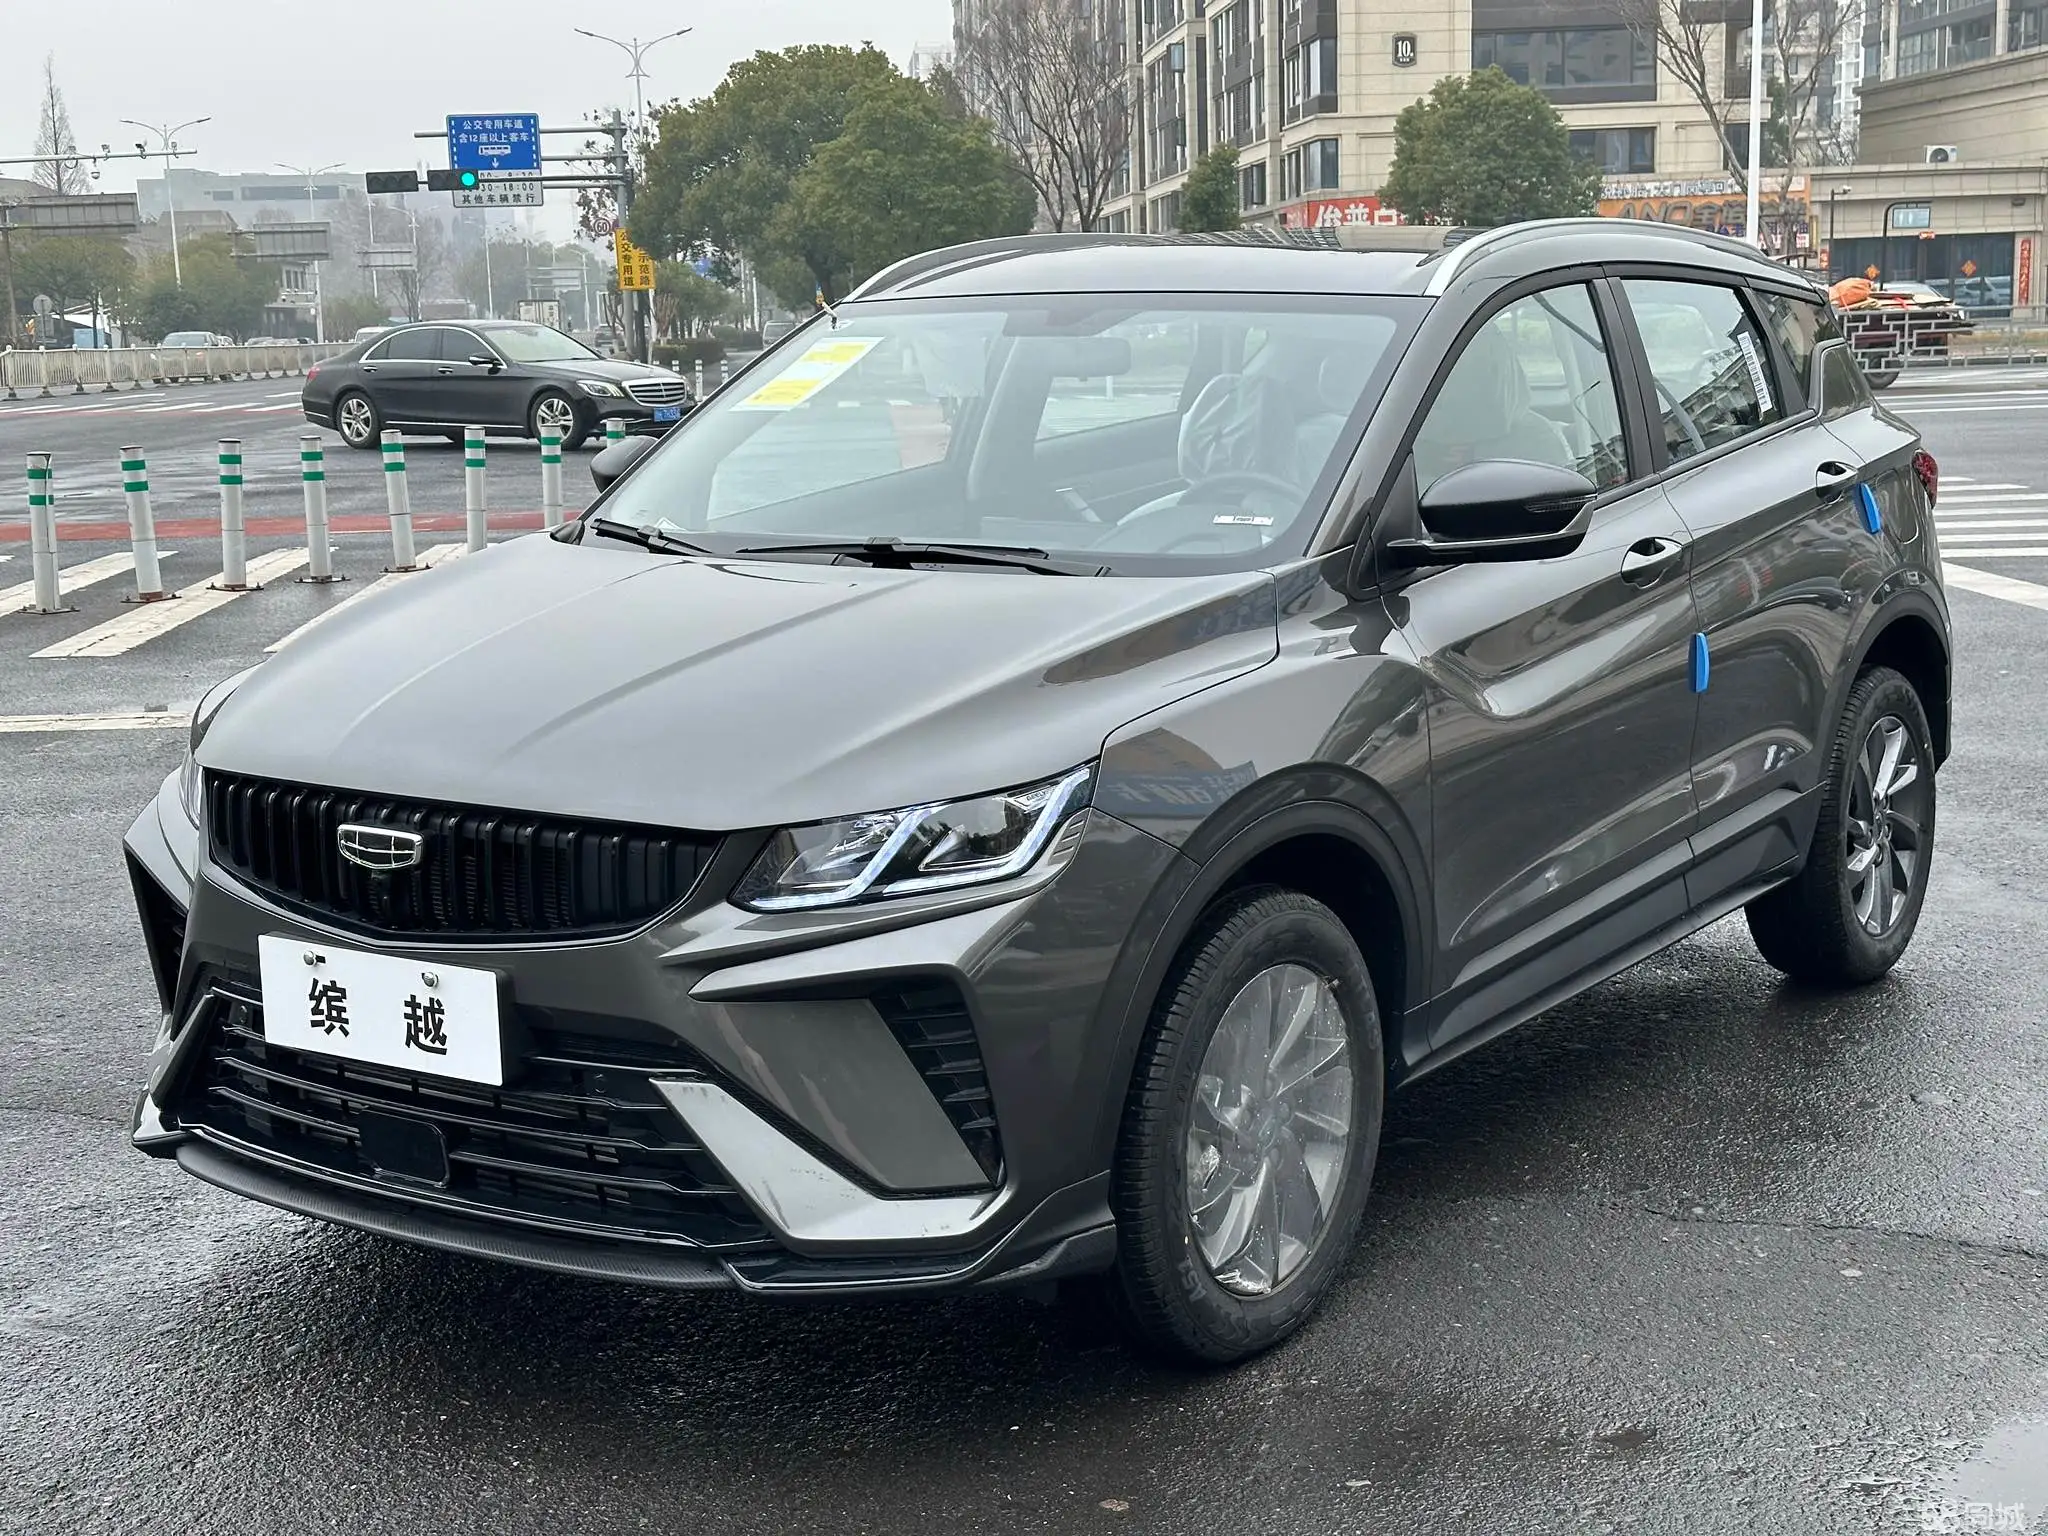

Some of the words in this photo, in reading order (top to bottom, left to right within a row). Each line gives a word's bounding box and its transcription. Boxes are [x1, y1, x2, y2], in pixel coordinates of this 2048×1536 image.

[462, 119, 524, 130] 公交专用车道
[458, 132, 529, 143] 含12座以上客车
[470, 182, 535, 192] 30-18:00
[462, 194, 536, 205] 其他车辆禁行
[596, 222, 608, 233] 60
[619, 232, 635, 287] 公交专用道
[637, 251, 651, 287] 示范路
[308, 977, 448, 1056] 缤越
